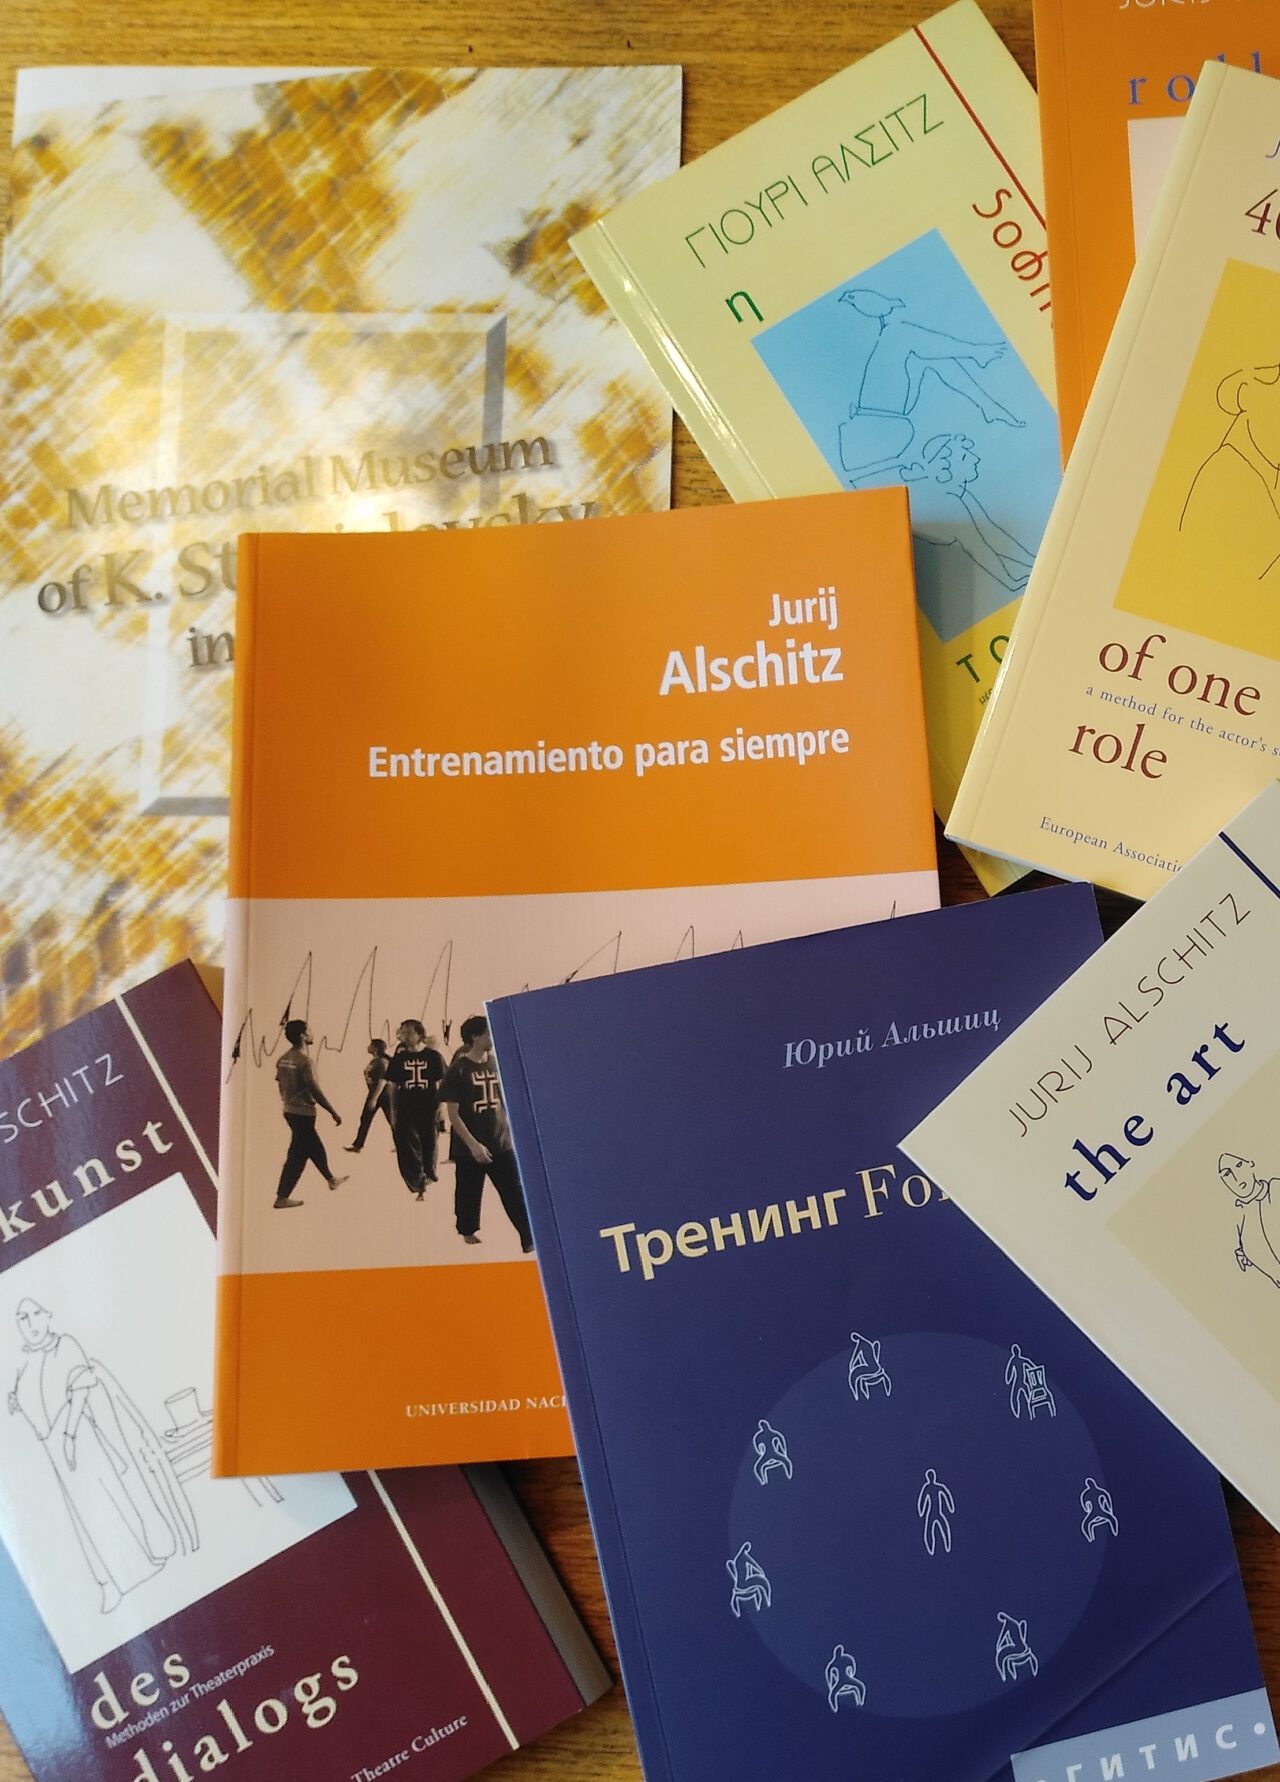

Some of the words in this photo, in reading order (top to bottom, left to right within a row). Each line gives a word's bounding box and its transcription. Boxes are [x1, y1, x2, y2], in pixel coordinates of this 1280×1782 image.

[66, 456, 315, 531] Memorial
[331, 435, 553, 495] Museum
[38, 564, 91, 614] of
[101, 550, 163, 607] K.
[768, 586, 838, 630] Jurij
[659, 638, 844, 696] Alschitz
[1098, 634, 1167, 681] of
[1167, 664, 1262, 716] one
[368, 740, 624, 778] Entrenamiento
[635, 737, 709, 776] para
[720, 727, 850, 765] siempre
[1068, 723, 1168, 780] role
[1086, 686, 1094, 697] a
[1100, 689, 1158, 717] method
[1162, 706, 1185, 727] for
[1189, 718, 1214, 736] the
[1218, 729, 1267, 753] actor's
[1040, 816, 1108, 851] European
[782, 1028, 875, 1069] Юрий
[880, 1007, 1001, 1049] Альшиц
[1009, 1044, 1094, 1139] JURIJ
[1103, 892, 1252, 1046] ALSCHITZ
[1064, 1114, 1154, 1202] the
[1166, 1021, 1246, 1106] art
[0, 1120, 174, 1243] kunst
[599, 1188, 847, 1281] Тренинг
[406, 1398, 520, 1417] UNIVERSIDAD
[90, 1652, 191, 1731] des
[105, 1705, 169, 1749] Methoden
[170, 1694, 191, 1715] zur
[189, 1643, 276, 1701] Theaterpraxis
[132, 1655, 359, 1782] dialogs
[411, 1715, 468, 1752] Culture
